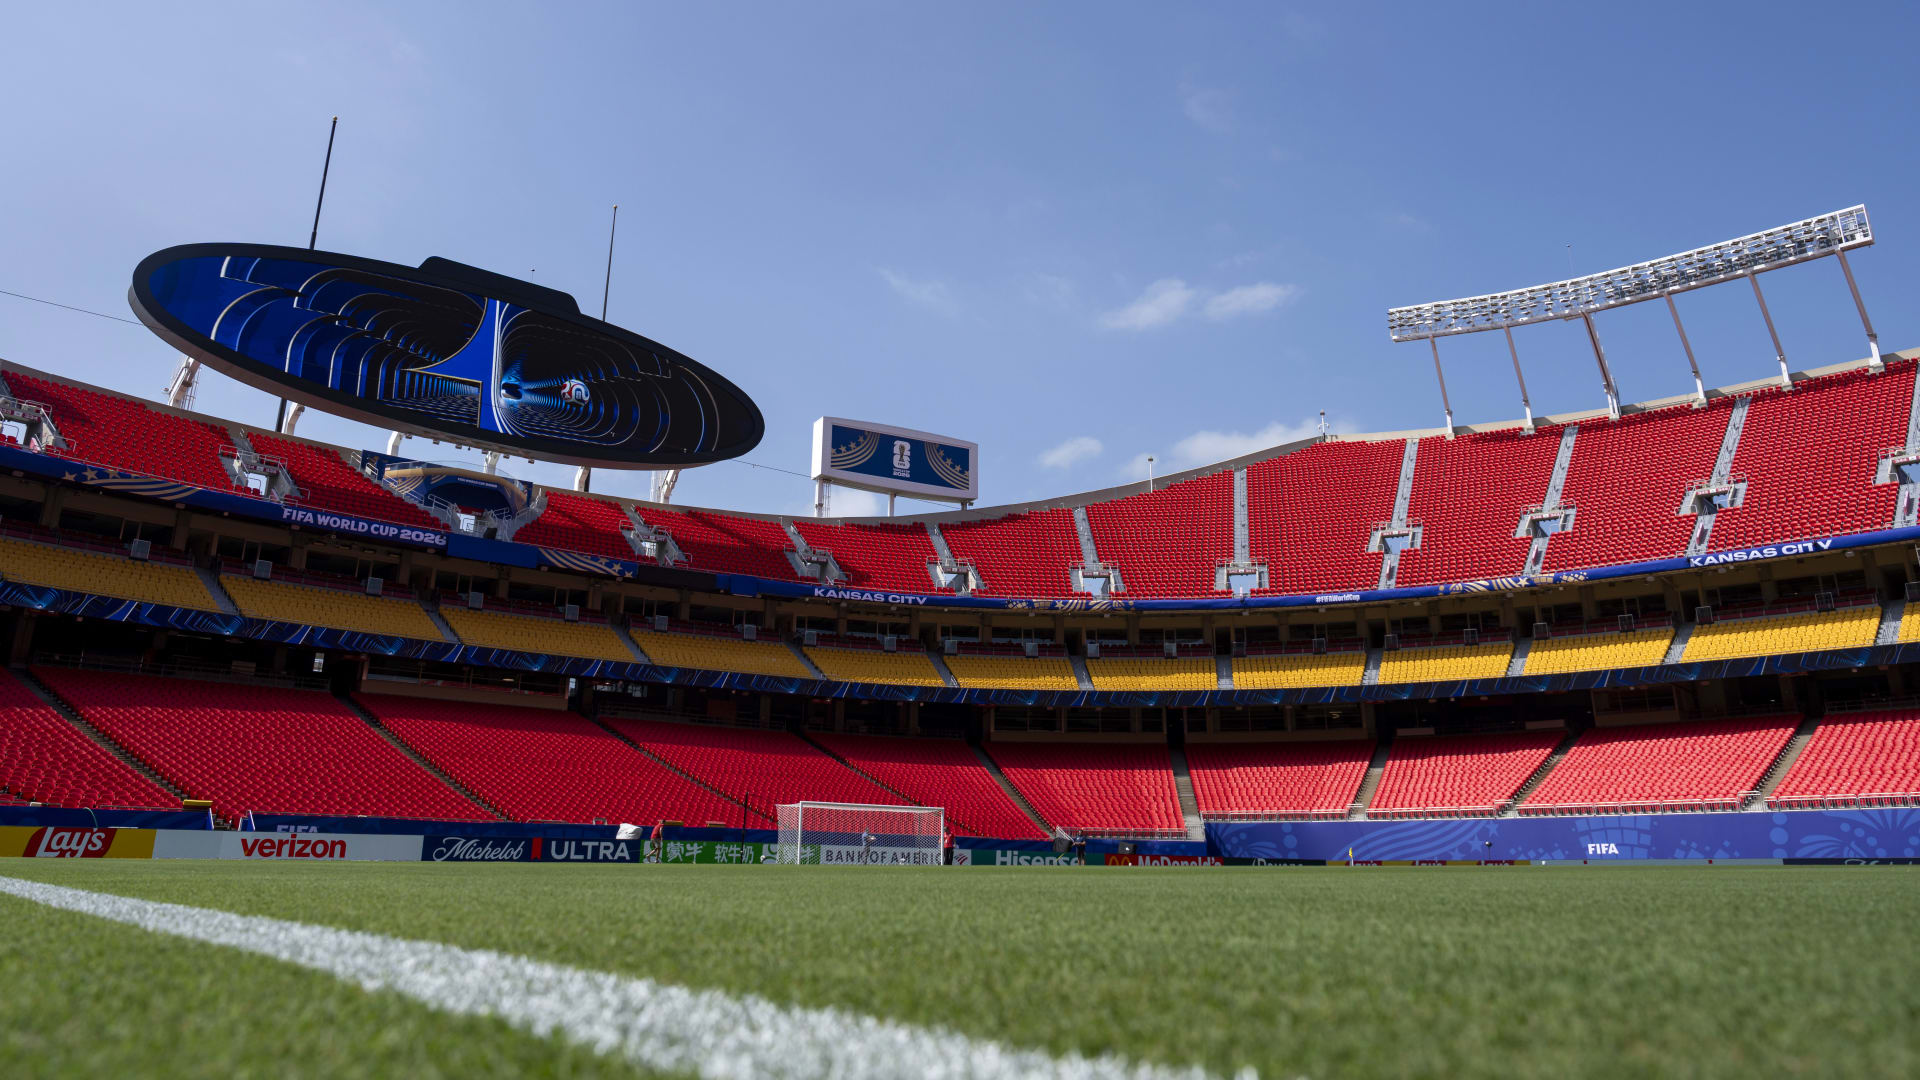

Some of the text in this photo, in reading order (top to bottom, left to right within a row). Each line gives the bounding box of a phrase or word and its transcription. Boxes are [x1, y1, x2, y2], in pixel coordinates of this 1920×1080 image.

[282, 508, 447, 546] FIFA WORLD CUP 2026
[1690, 539, 1833, 567] KANSAS CITY
[814, 588, 928, 605] KANSAS CITY
[276, 824, 318, 833] FIFA
[36, 826, 106, 858] Lay's
[241, 833, 347, 859] verizon
[432, 836, 631, 862] Michelob ULTRA
[1587, 843, 1619, 855] FIFA
[825, 849, 943, 865] BANK OF AMERIC
